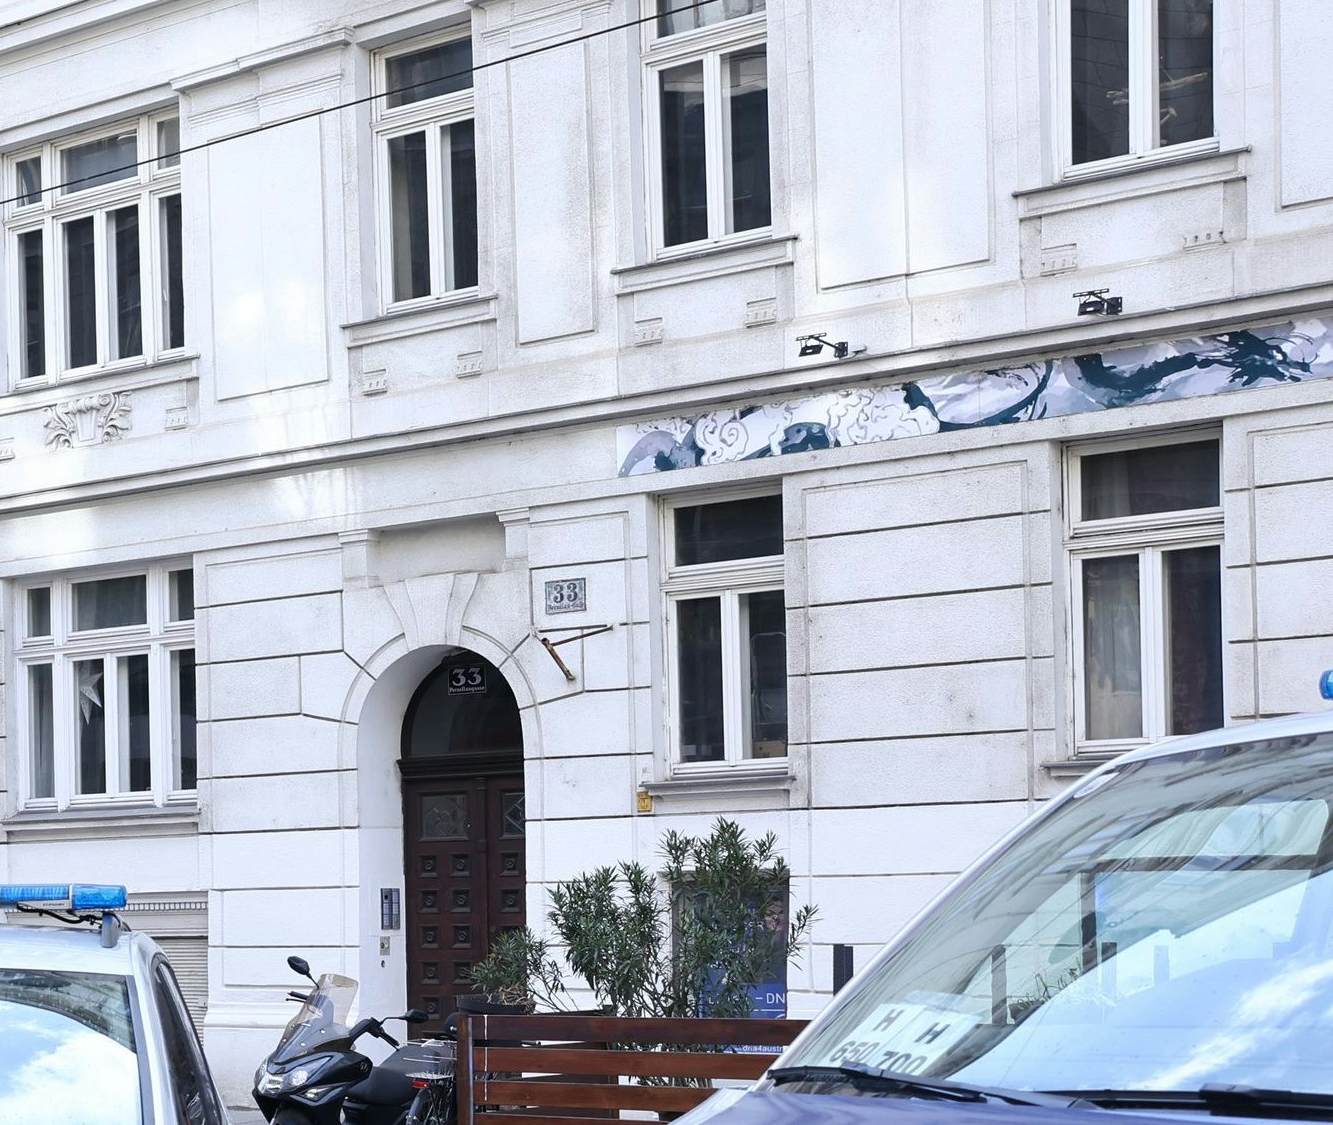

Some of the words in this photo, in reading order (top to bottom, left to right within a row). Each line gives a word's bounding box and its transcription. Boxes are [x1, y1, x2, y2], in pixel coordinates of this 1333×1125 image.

[553, 583, 578, 604] 33
[452, 668, 482, 687] 33
[766, 992, 785, 1004] DN
[873, 1009, 904, 1032] H
[915, 1022, 951, 1045] H
[829, 1040, 881, 1063] 650
[876, 1051, 928, 1075] 700
